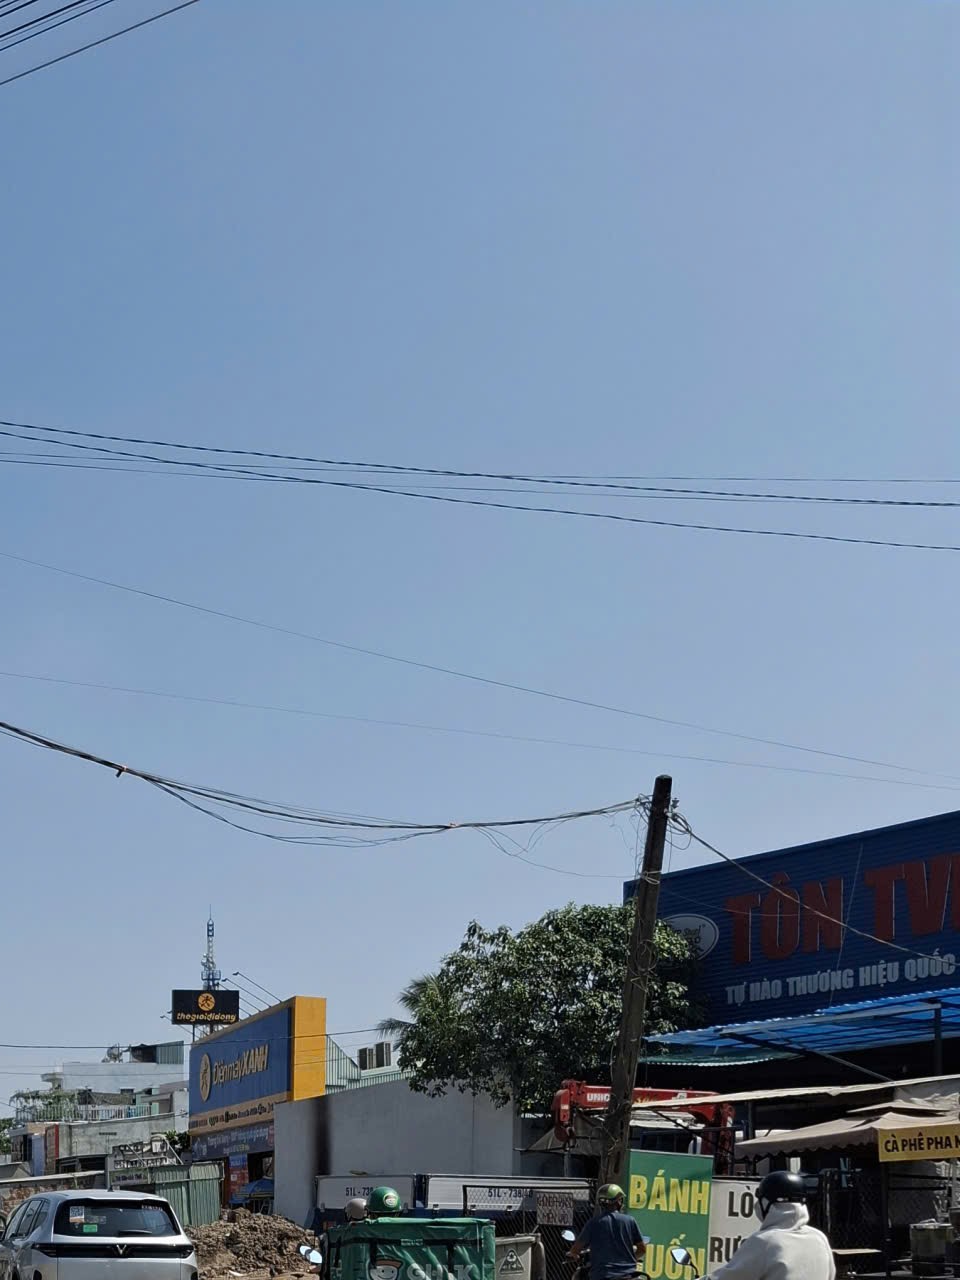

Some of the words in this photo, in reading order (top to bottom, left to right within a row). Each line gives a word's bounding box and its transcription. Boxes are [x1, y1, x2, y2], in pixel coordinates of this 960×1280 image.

[723, 871, 844, 965] TÔN
[864, 853, 960, 941] TV
[725, 981, 748, 1006] TỰ
[750, 977, 782, 1003] HÀO
[786, 967, 854, 996] THƯƠNG
[859, 959, 899, 988] HIỆU
[904, 948, 956, 981] QUỐC
[884, 1134, 899, 1153] CÀ
[902, 1132, 926, 1151] PHÊ
[928, 1136, 953, 1150] PHA
[628, 1169, 710, 1215] BÁNH
[637, 1234, 706, 1280] UỐN
